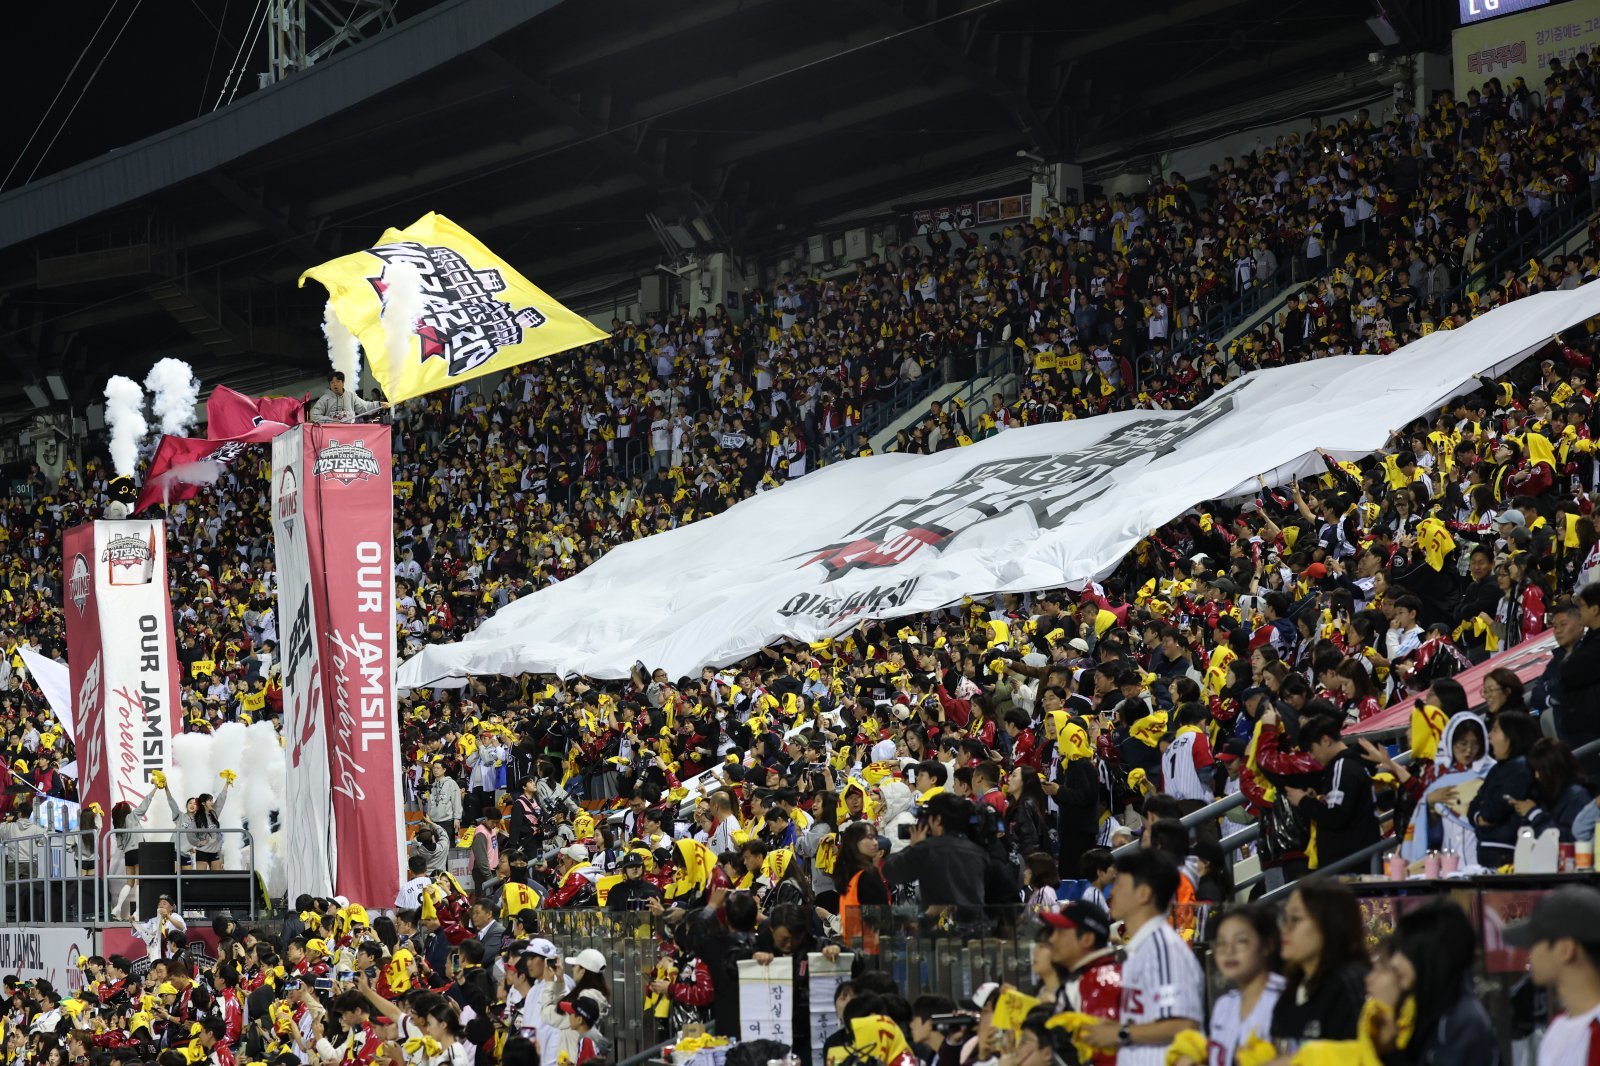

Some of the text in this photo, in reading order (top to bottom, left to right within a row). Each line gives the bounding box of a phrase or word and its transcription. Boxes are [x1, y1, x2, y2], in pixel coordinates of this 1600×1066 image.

[1536, 23, 1581, 46] 경기중에는
[1467, 41, 1527, 75] 타구주의
[313, 458, 379, 475] POSTSEASON
[16, 483, 31, 495] 301
[278, 490, 298, 521] TWINS
[102, 547, 150, 562] POSTSEASON
[69, 573, 91, 600] TWINS
[357, 541, 386, 751] OUR JAMSIL
[138, 614, 164, 784] OUR JAMSIL
[325, 628, 368, 810] Forever LG
[112, 685, 149, 785] Forever
[1170, 753, 1177, 779] 1
[774, 850, 785, 875] WINS
[12, 933, 43, 970] JAMSIL
